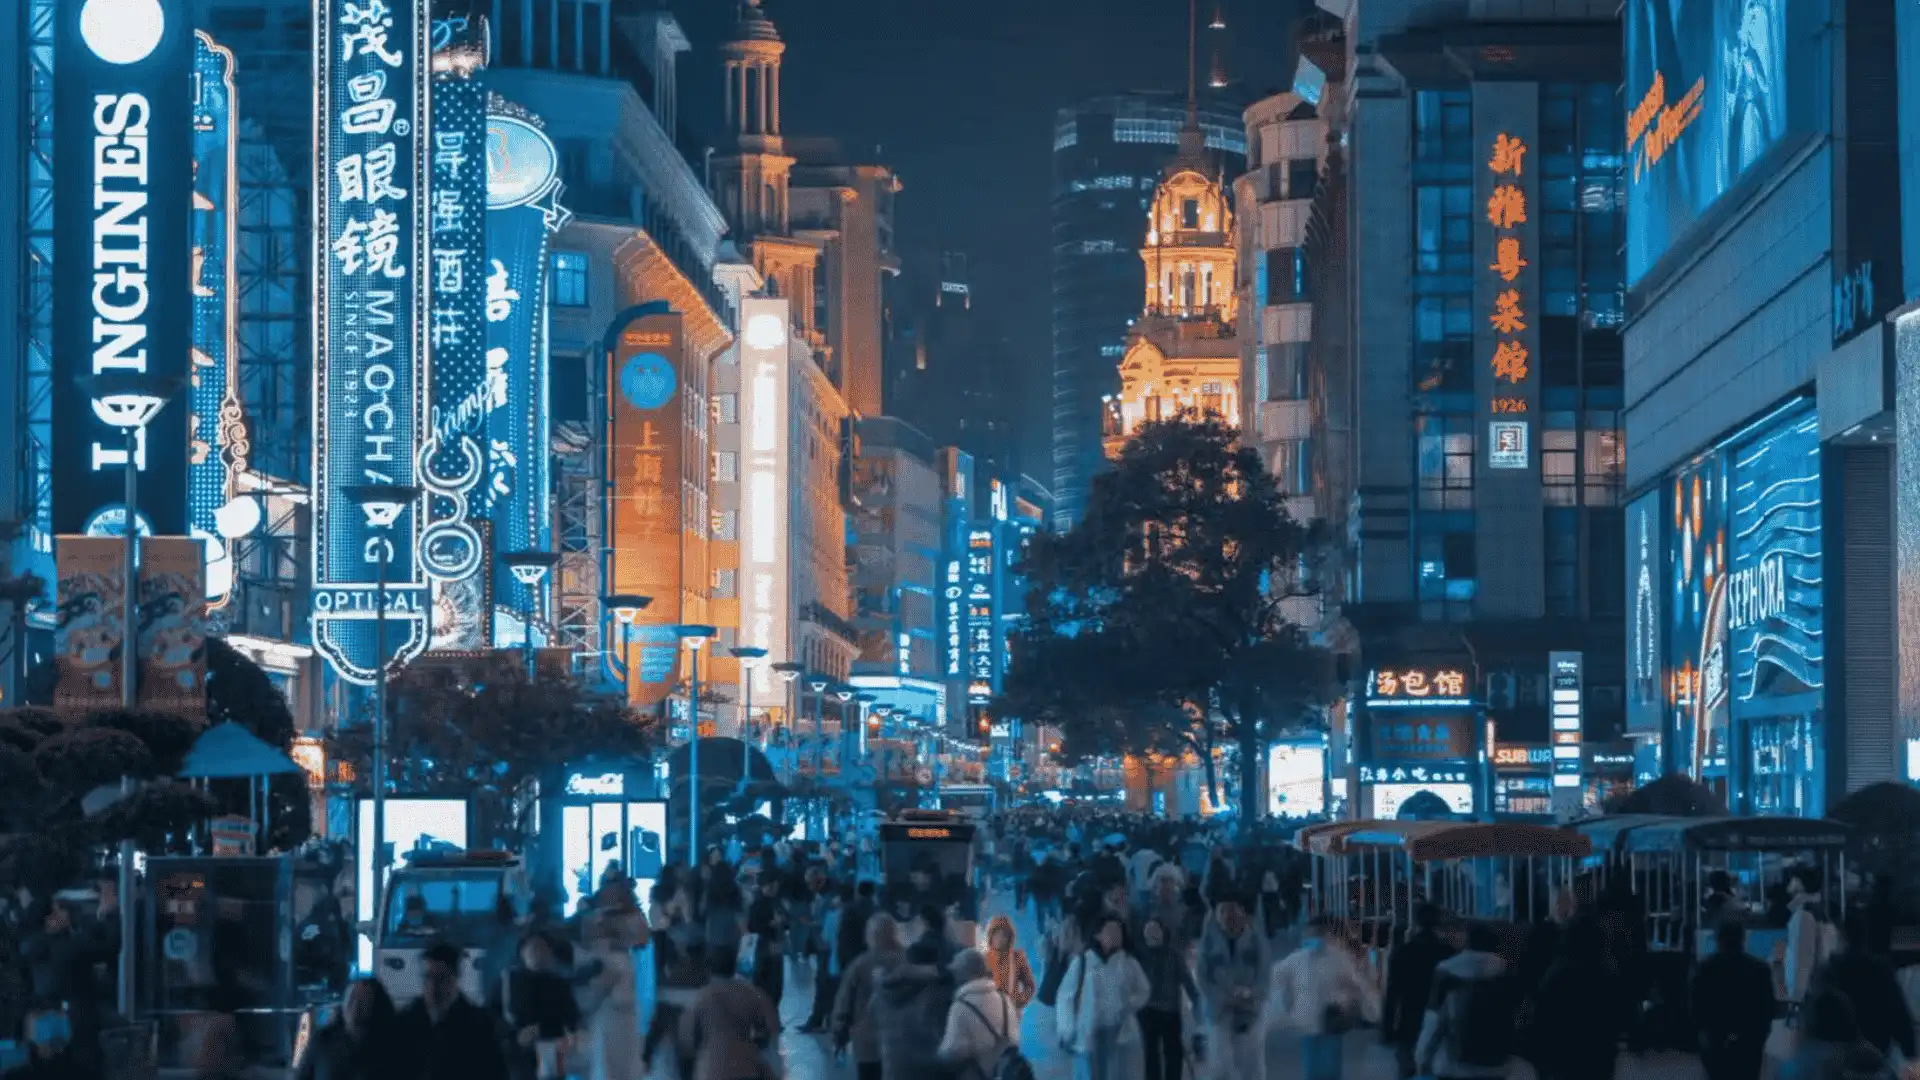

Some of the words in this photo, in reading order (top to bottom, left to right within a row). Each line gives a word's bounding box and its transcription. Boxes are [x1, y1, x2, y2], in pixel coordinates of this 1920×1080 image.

[331, 0, 408, 278] 茂昌眼镜
[344, 290, 359, 354] SINCE
[363, 289, 395, 564] MAOCHAG
[1491, 398, 1528, 413] 1926
[1729, 554, 1786, 629] SEPHORA
[1376, 669, 1465, 696] 汤包馆
[1495, 749, 1551, 763] SUBWA
